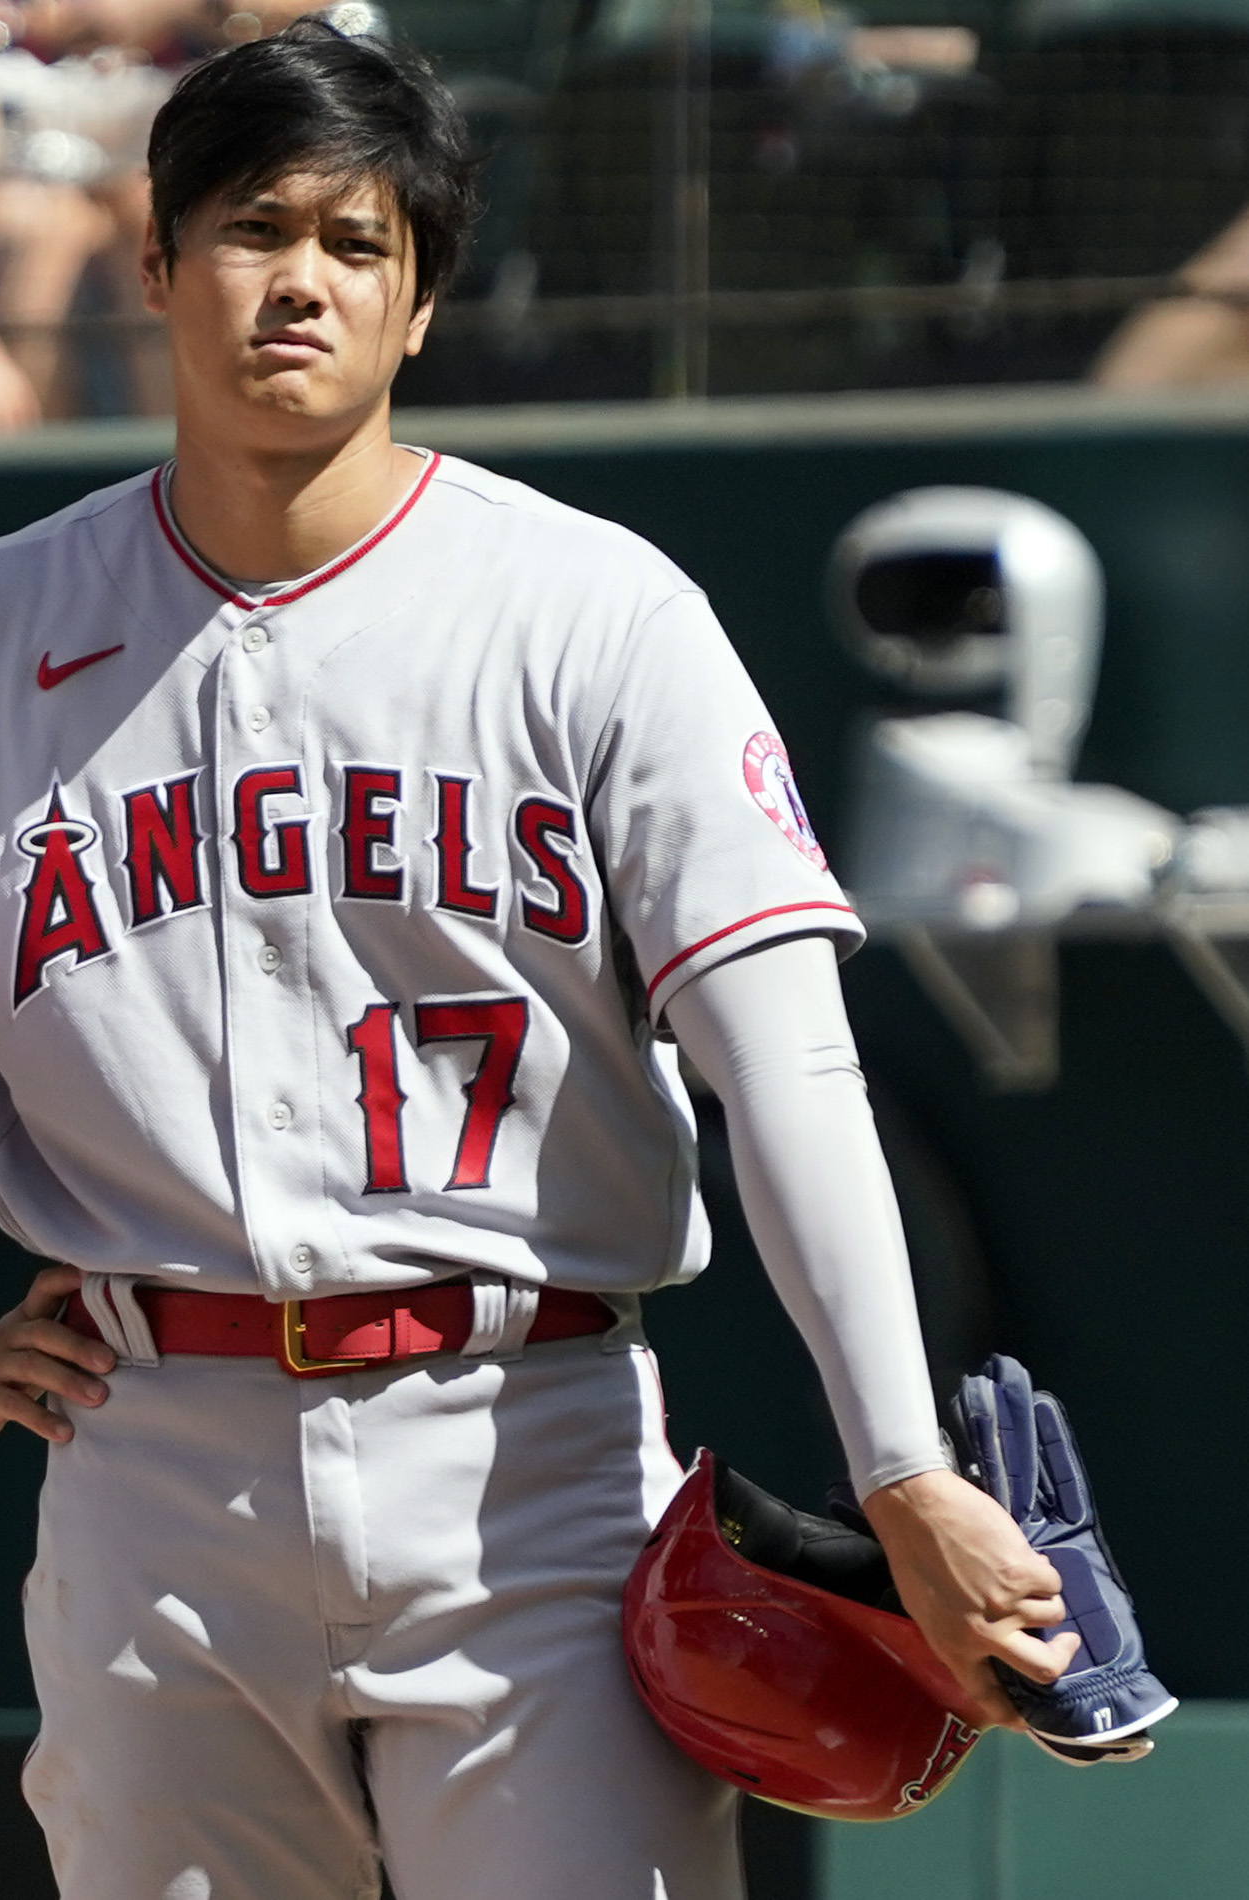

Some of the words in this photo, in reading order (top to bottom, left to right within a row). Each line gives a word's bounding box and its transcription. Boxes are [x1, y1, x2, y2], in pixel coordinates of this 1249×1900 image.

[12, 761, 603, 1016] ANGELS
[347, 996, 528, 1196] 17
[1093, 1707, 1112, 1732] 17
